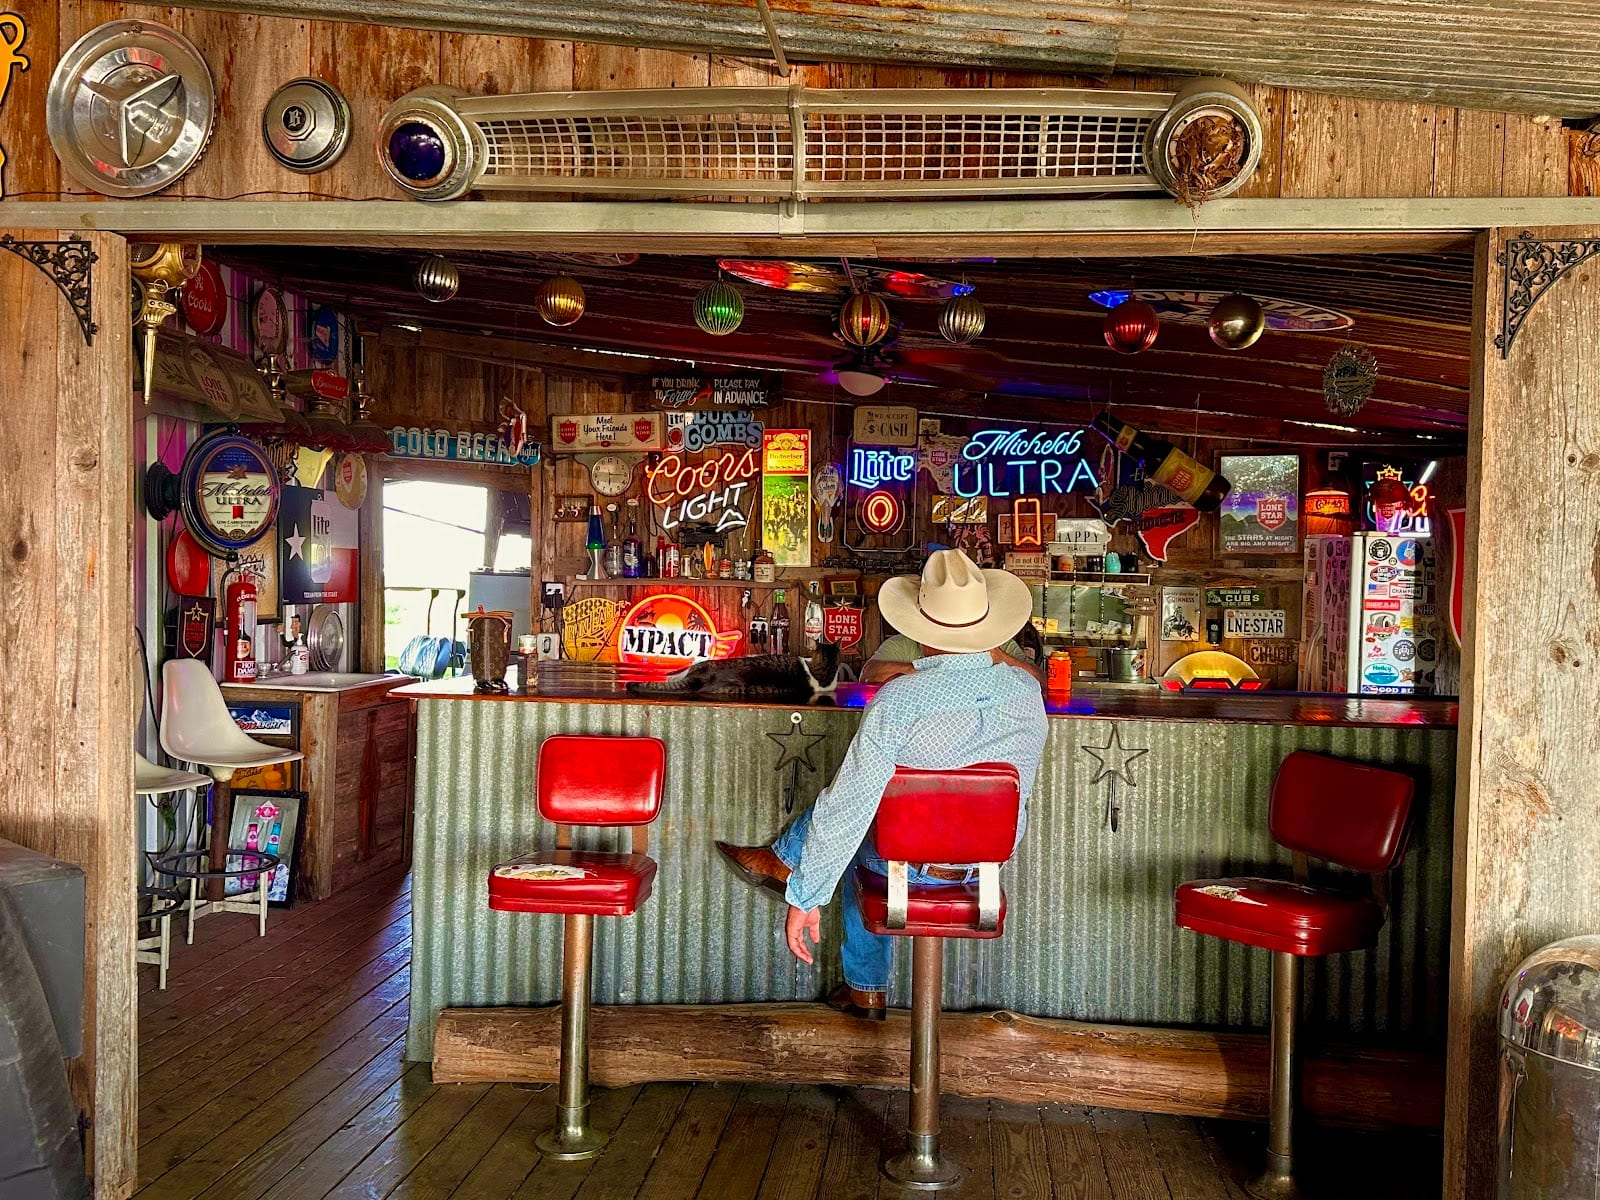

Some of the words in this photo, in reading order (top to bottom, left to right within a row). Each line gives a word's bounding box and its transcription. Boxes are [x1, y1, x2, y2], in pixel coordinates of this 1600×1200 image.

[187, 290, 212, 313] Coors
[652, 378, 659, 388] IF
[661, 377, 674, 388] YOU
[676, 377, 700, 388] DRINK
[714, 378, 743, 389] PLEASE
[744, 379, 760, 389] PAY
[654, 390, 663, 400] TO
[661, 388, 698, 408] Forget
[713, 390, 723, 404] IN
[596, 416, 614, 425] Meet
[583, 424, 601, 435] Your
[602, 424, 628, 433] Friends
[684, 421, 763, 451] COMBS
[880, 423, 908, 437] CASH
[391, 425, 450, 459] COLD
[962, 428, 1085, 461] Michelob
[648, 448, 760, 504] Coors
[849, 449, 914, 489] Lite
[954, 458, 1098, 498] ULTRA
[216, 496, 263, 506] ULTRA
[662, 481, 748, 529] LIGHT
[1260, 504, 1283, 512] LONE
[1260, 512, 1283, 520] STAR
[1225, 594, 1260, 602] CUBS
[829, 614, 858, 624] LONE
[828, 625, 858, 635] STAR
